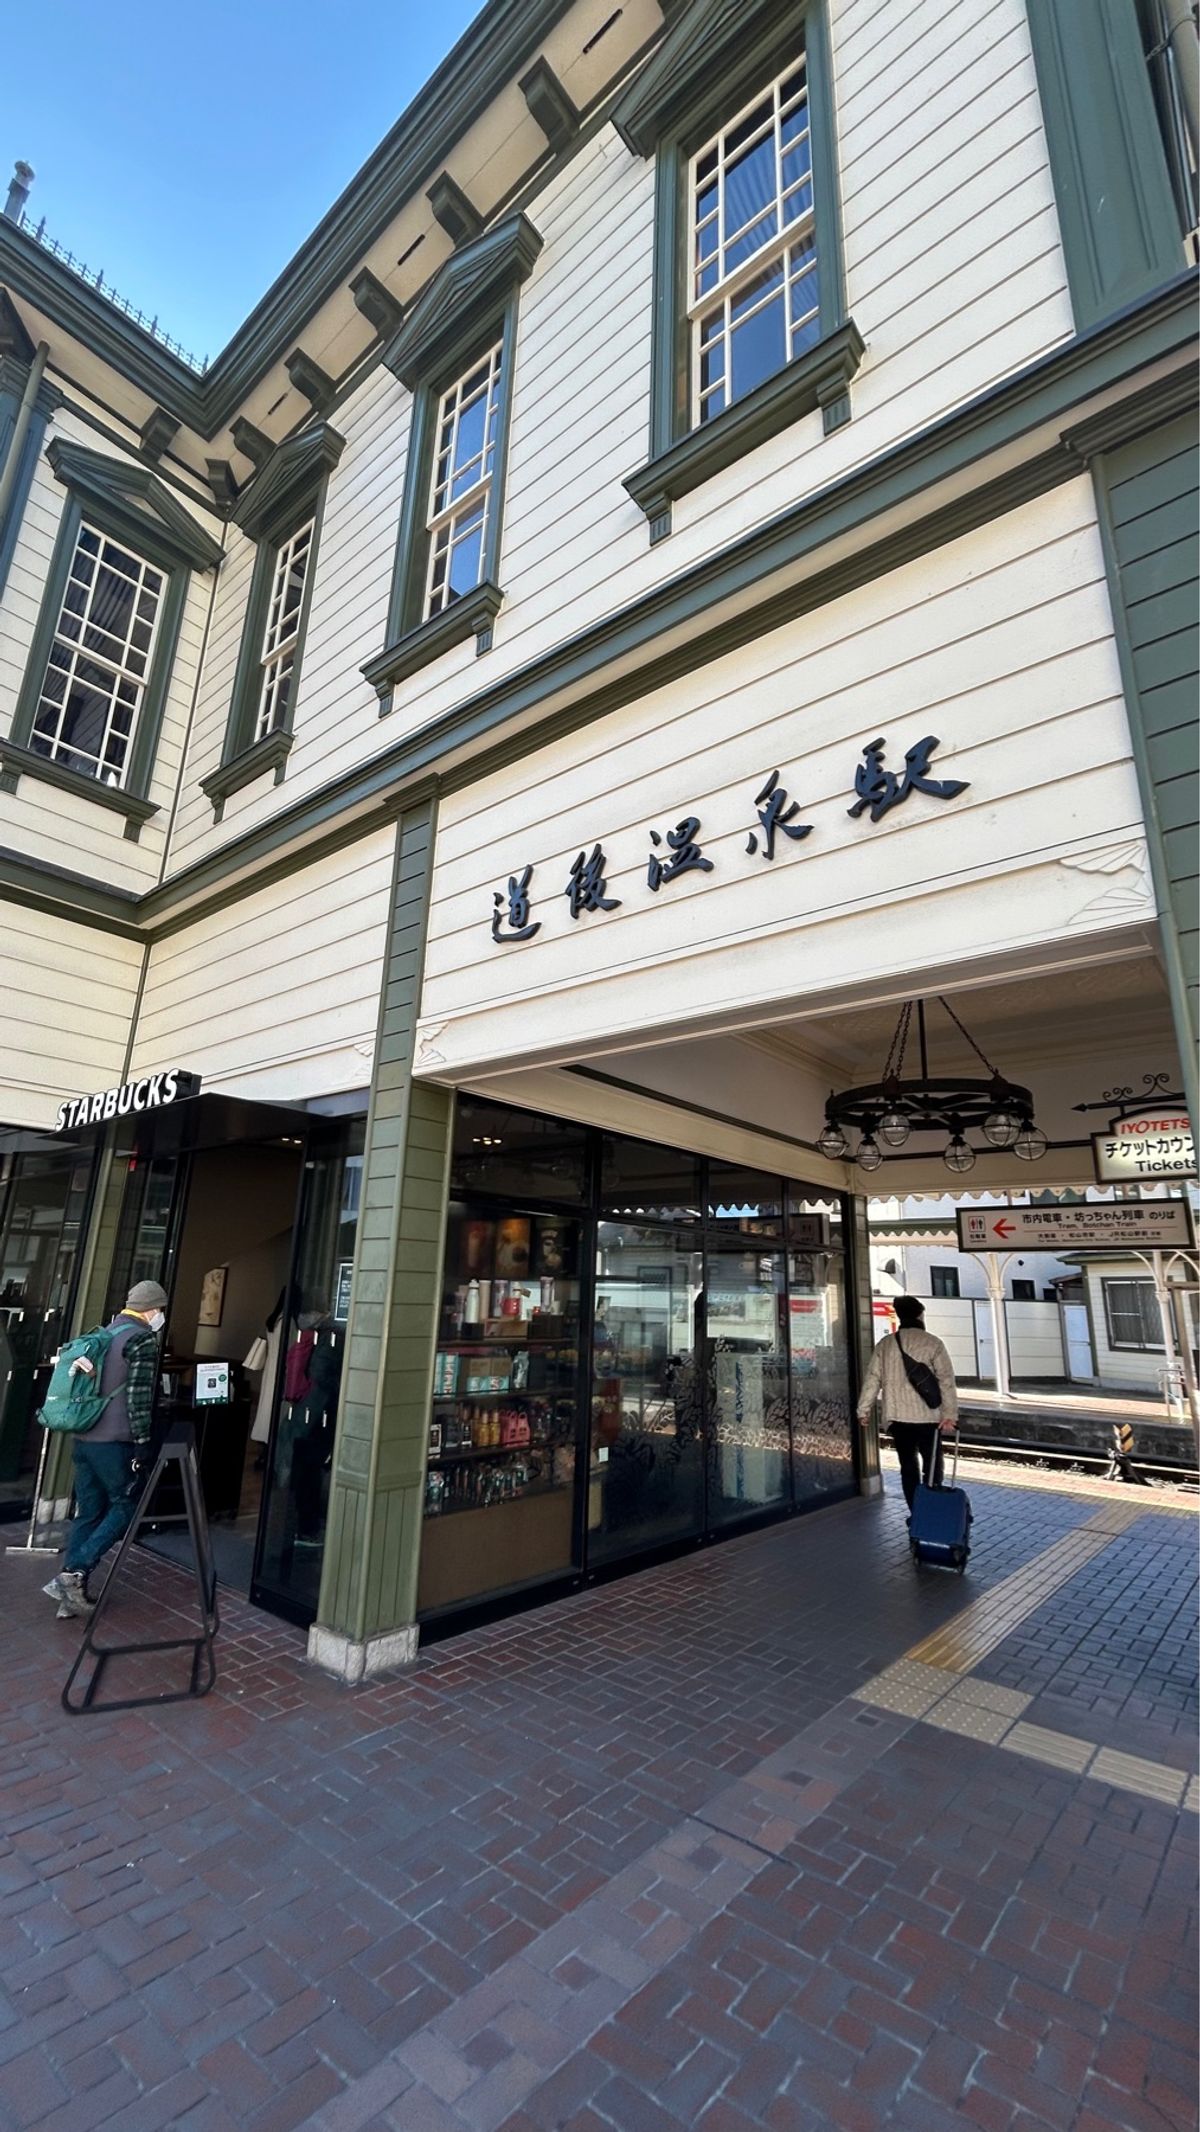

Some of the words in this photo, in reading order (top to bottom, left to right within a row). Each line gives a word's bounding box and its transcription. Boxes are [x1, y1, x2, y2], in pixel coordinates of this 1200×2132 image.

[56, 1068, 179, 1132] STARBUCKS
[1149, 1211, 1175, 1220] のりば
